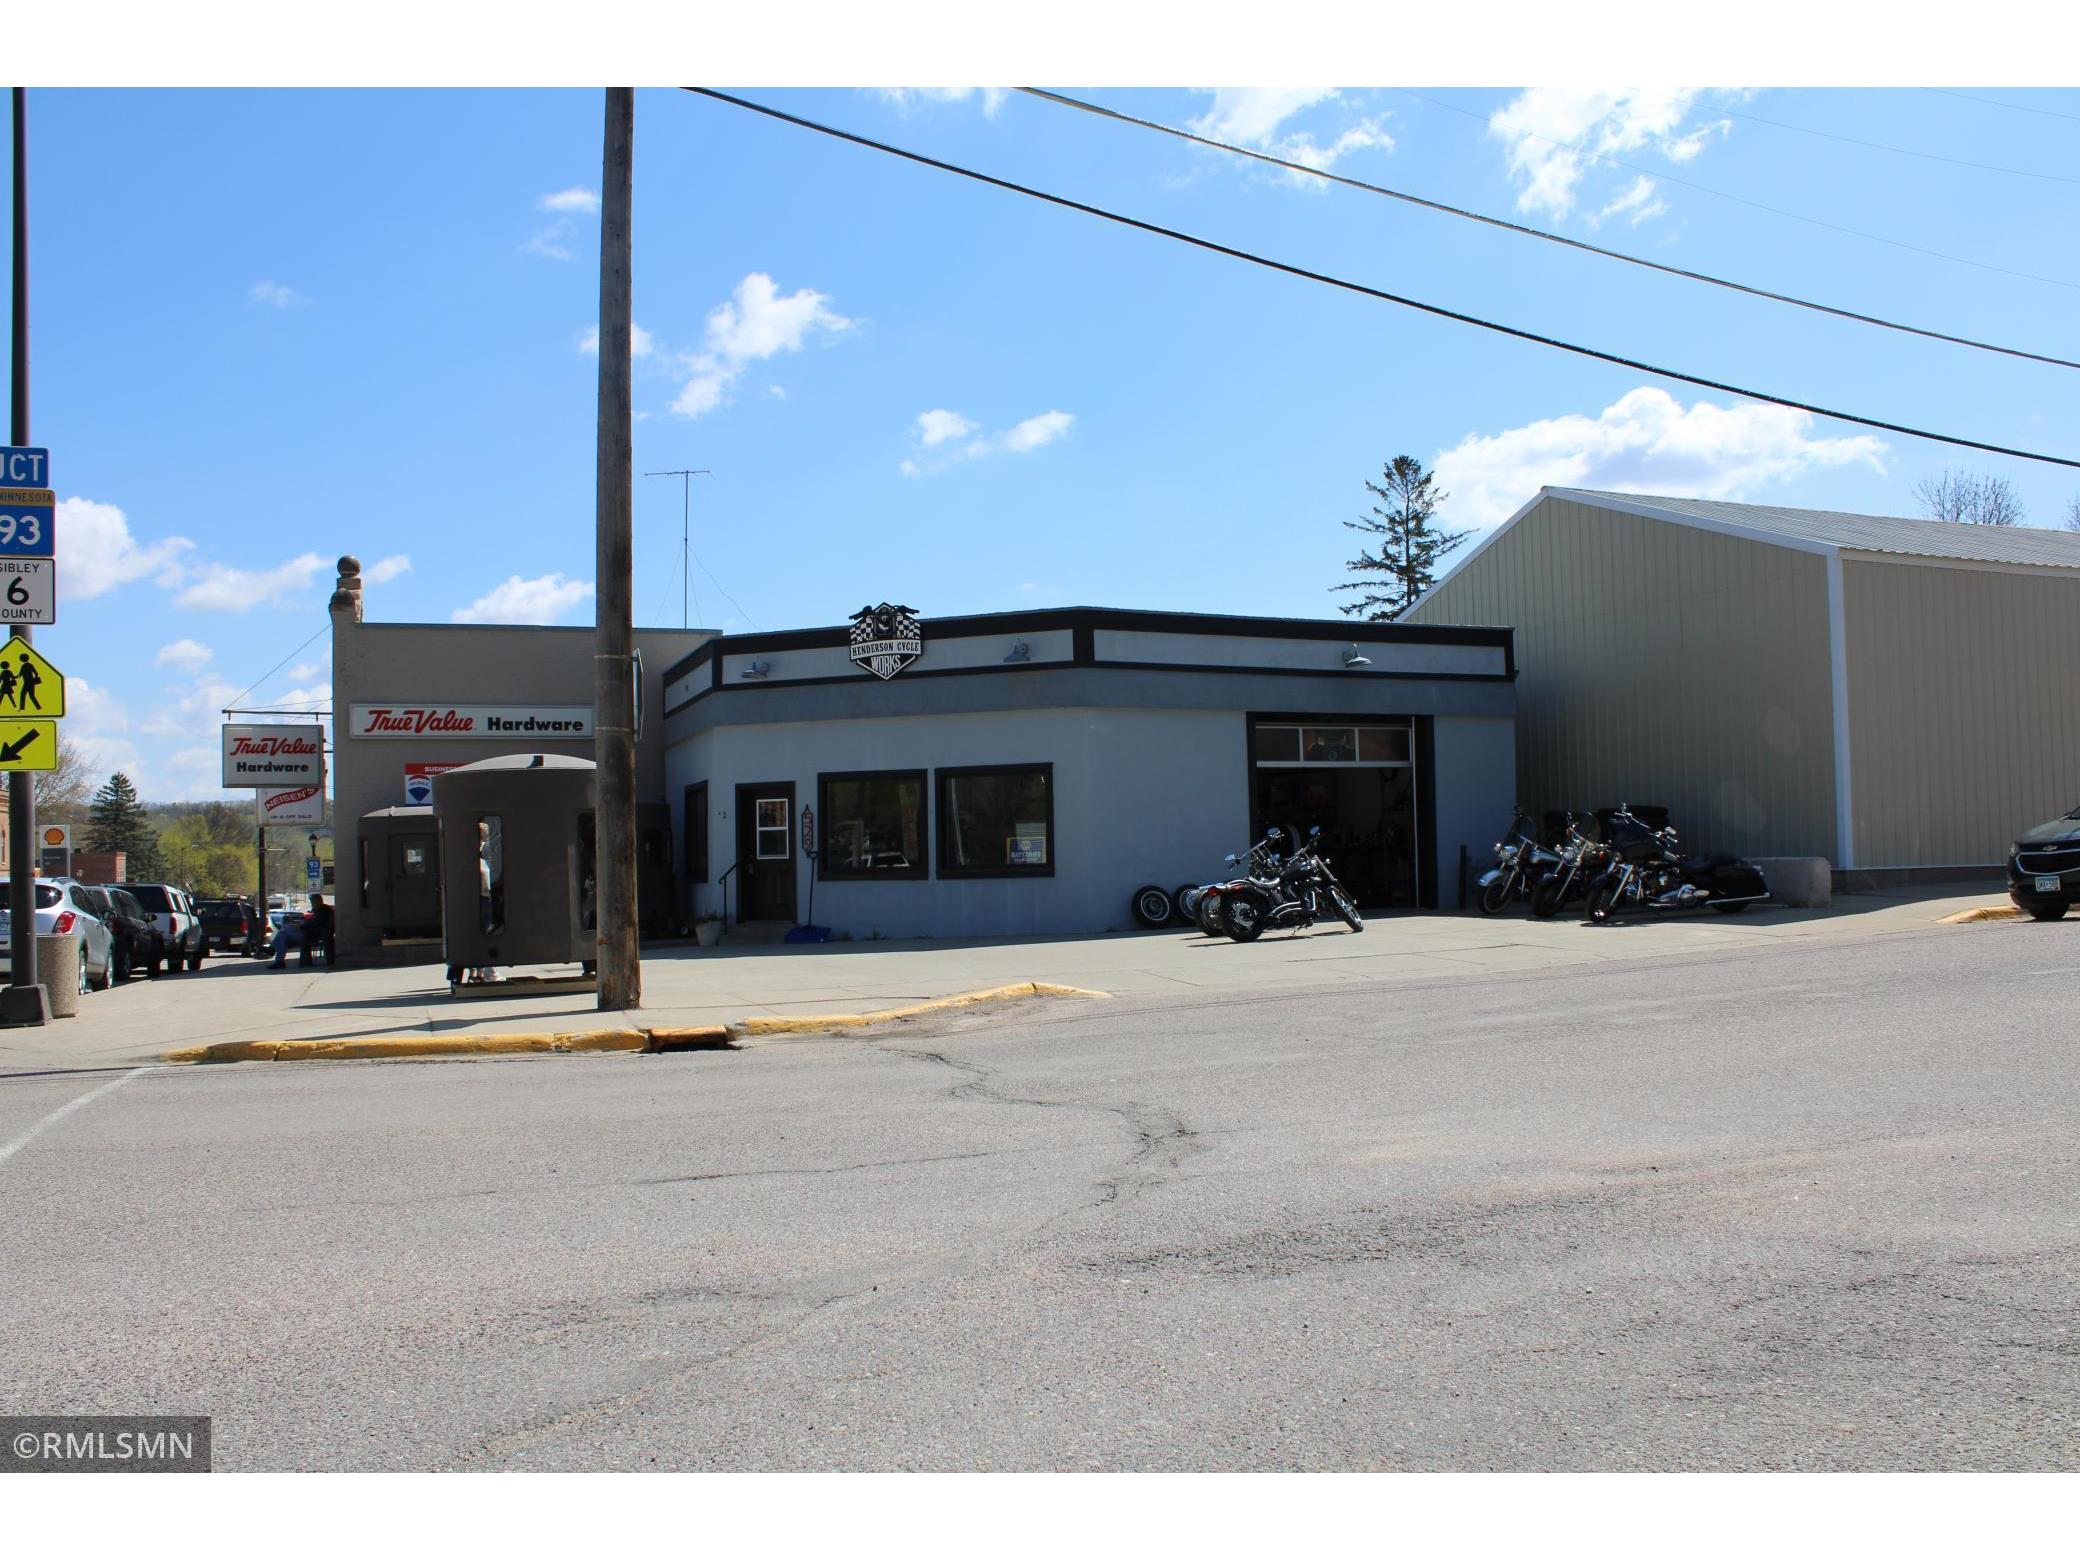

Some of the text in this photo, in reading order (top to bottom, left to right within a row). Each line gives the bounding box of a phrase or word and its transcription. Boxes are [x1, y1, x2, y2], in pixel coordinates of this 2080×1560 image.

[0, 514, 41, 545] 93
[7, 575, 30, 606] 6
[0, 608, 43, 619] OUNTY
[852, 641, 919, 657] HENDERSON CYCLE
[871, 654, 901, 677] WORKS
[487, 716, 584, 732] Hardware
[236, 761, 309, 773] Hardware
